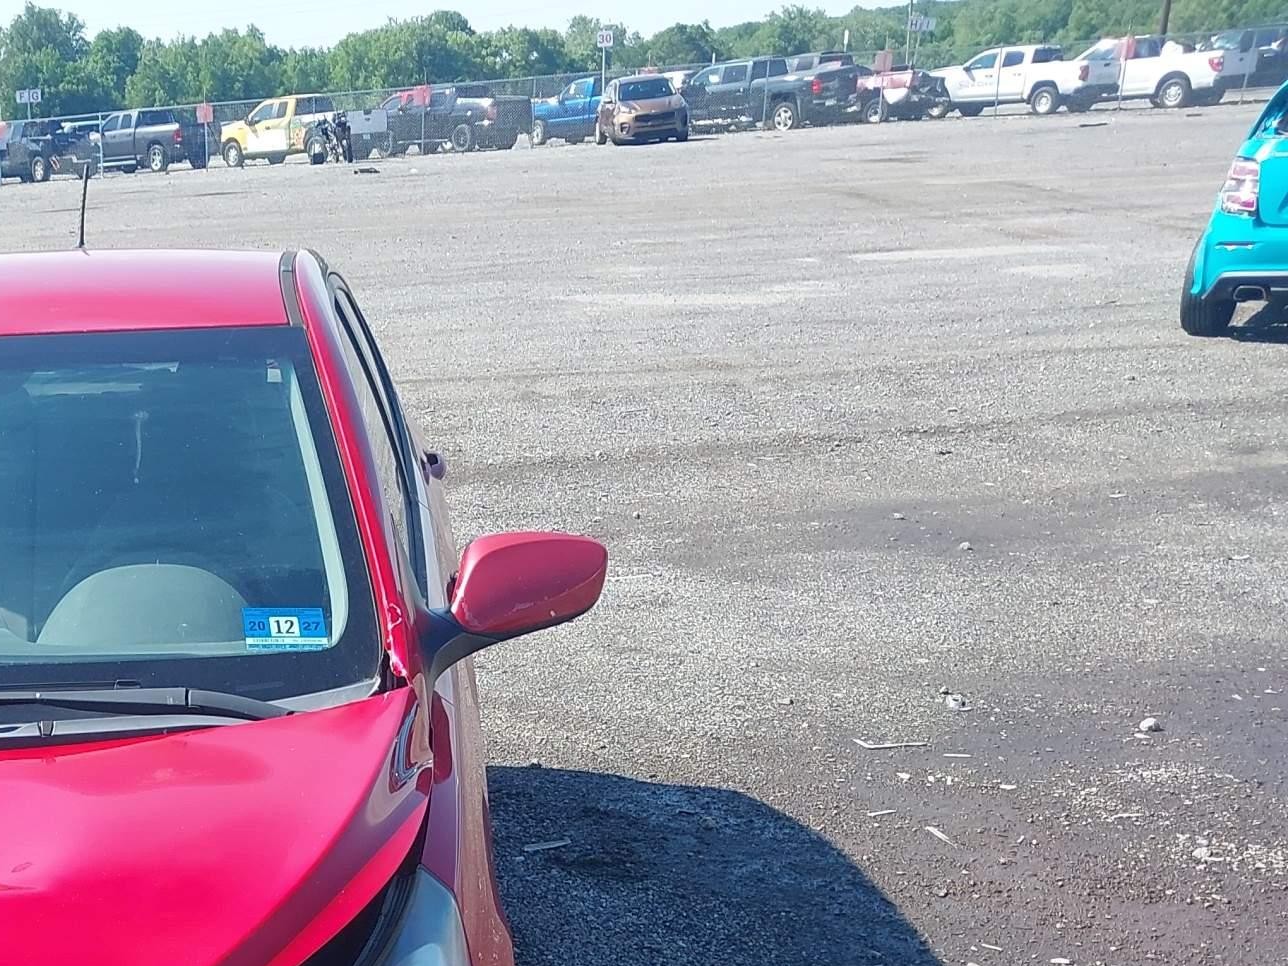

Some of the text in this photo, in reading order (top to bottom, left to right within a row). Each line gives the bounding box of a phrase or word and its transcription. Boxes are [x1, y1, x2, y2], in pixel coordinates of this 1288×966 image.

[599, 34, 612, 44] 30
[31, 91, 39, 101] G
[248, 619, 321, 635] 20 12 27
